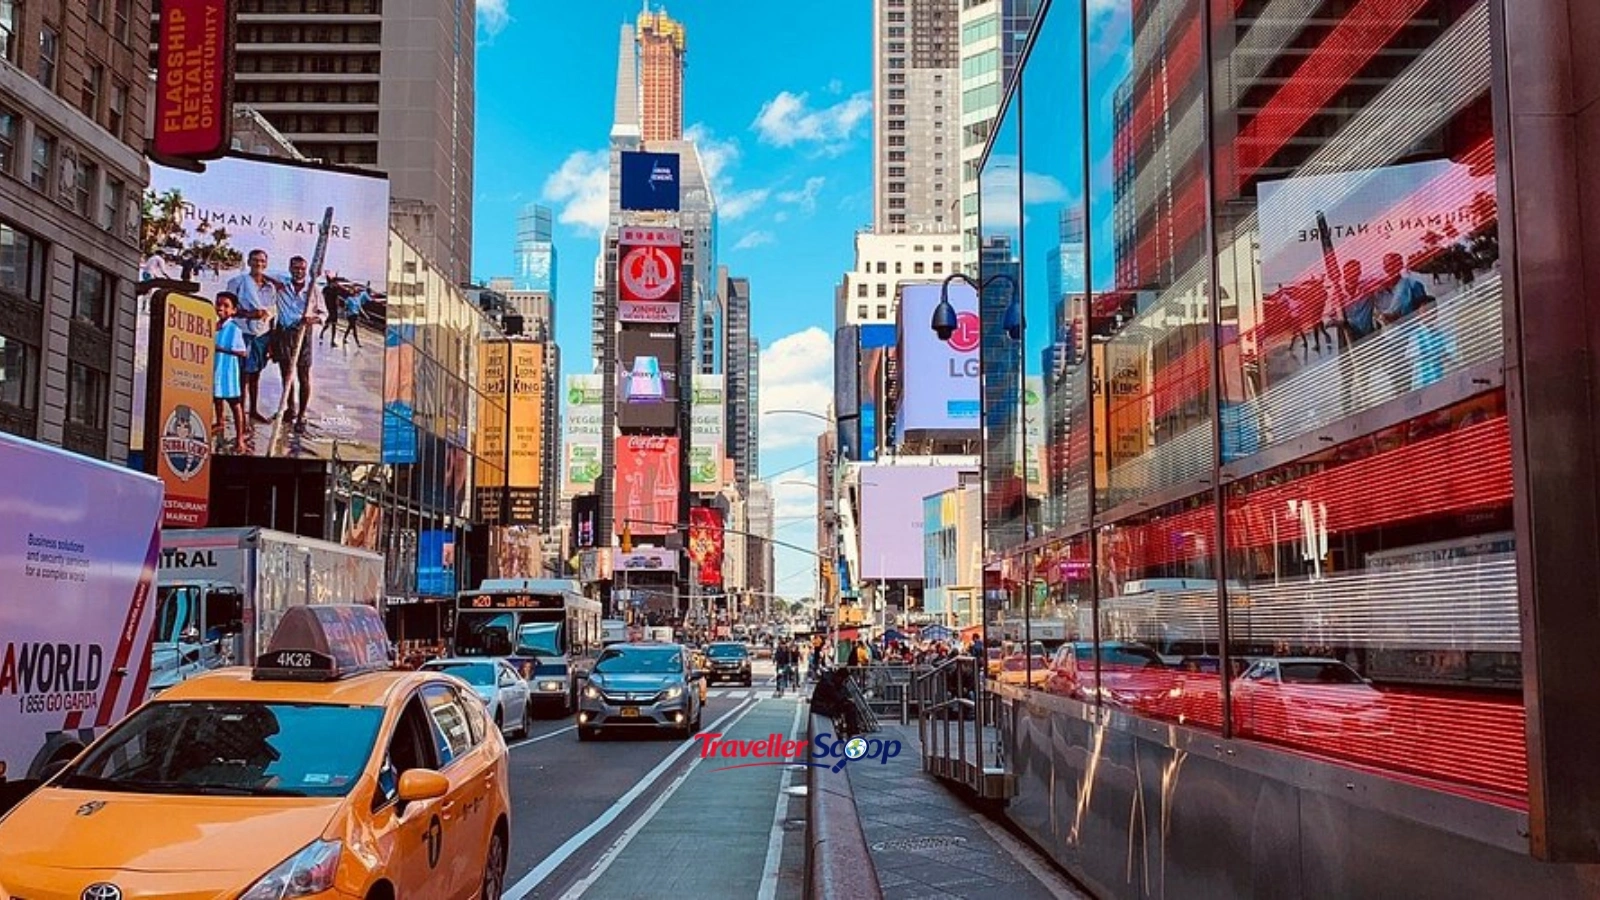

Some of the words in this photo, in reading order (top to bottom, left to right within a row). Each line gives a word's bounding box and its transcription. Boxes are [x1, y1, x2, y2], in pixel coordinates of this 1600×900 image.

[164, 8, 186, 132] FLAGSHIP
[201, 5, 218, 129] OPPORTUNITY
[182, 44, 203, 130] RETAIL
[184, 205, 252, 226] HUMAN
[632, 305, 668, 314] XINHUA
[168, 303, 212, 338] BUBBA
[170, 334, 209, 365] GUMP
[949, 357, 980, 378] LG
[513, 379, 540, 393] KING
[166, 512, 199, 522] MARKET
[28, 532, 57, 549] Business
[58, 538, 84, 553] solutions
[159, 547, 217, 569] TRAL
[277, 652, 311, 667] 4K26
[19, 695, 24, 713] 1
[26, 694, 45, 713] 855
[47, 693, 62, 711] GO
[64, 692, 97, 710] GARDA
